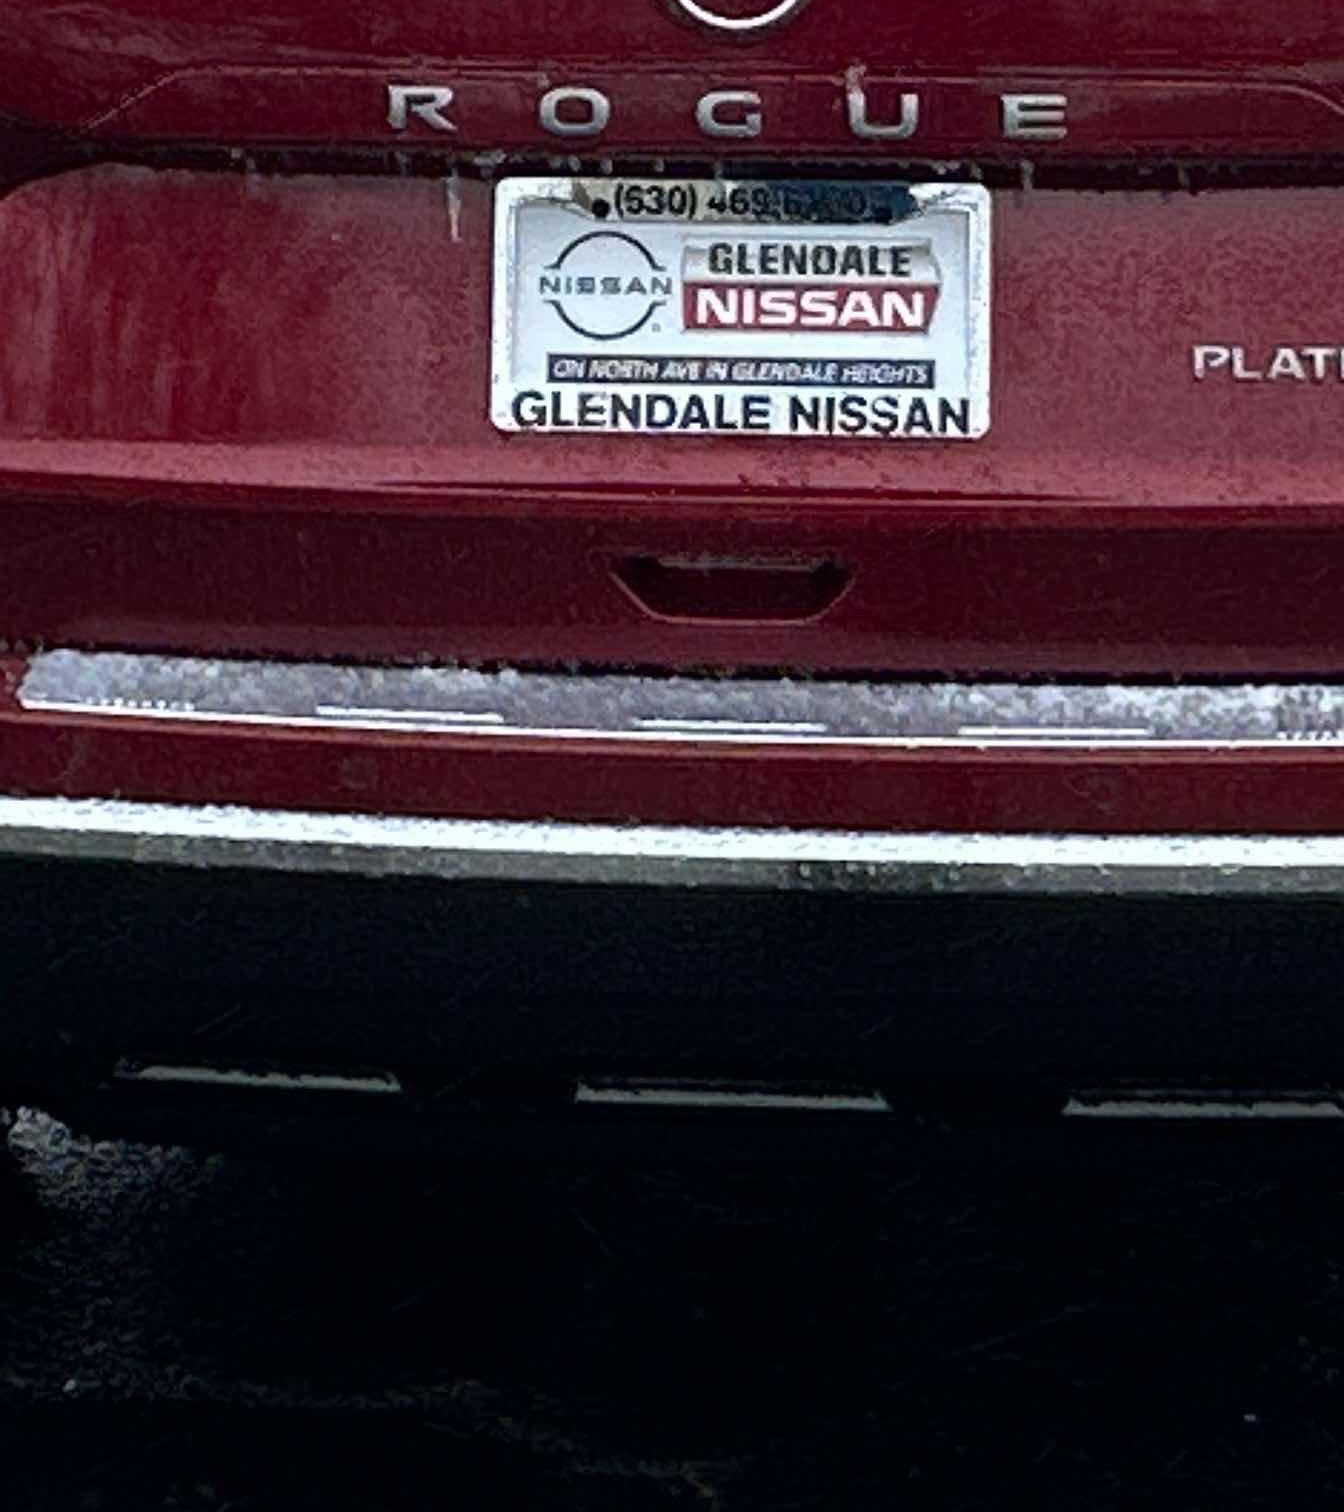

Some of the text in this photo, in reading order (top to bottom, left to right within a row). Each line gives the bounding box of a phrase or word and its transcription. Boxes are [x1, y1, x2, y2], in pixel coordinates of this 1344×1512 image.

[388, 85, 1068, 139] ROGUE
[709, 242, 912, 277] GLENDALE
[540, 276, 672, 295] NISSAN
[696, 288, 925, 327] NISSAN
[554, 361, 928, 385] ON NORTH AVE IN GLENDALE HEIGHTS
[511, 390, 970, 435] GLENDALE NISSAN
